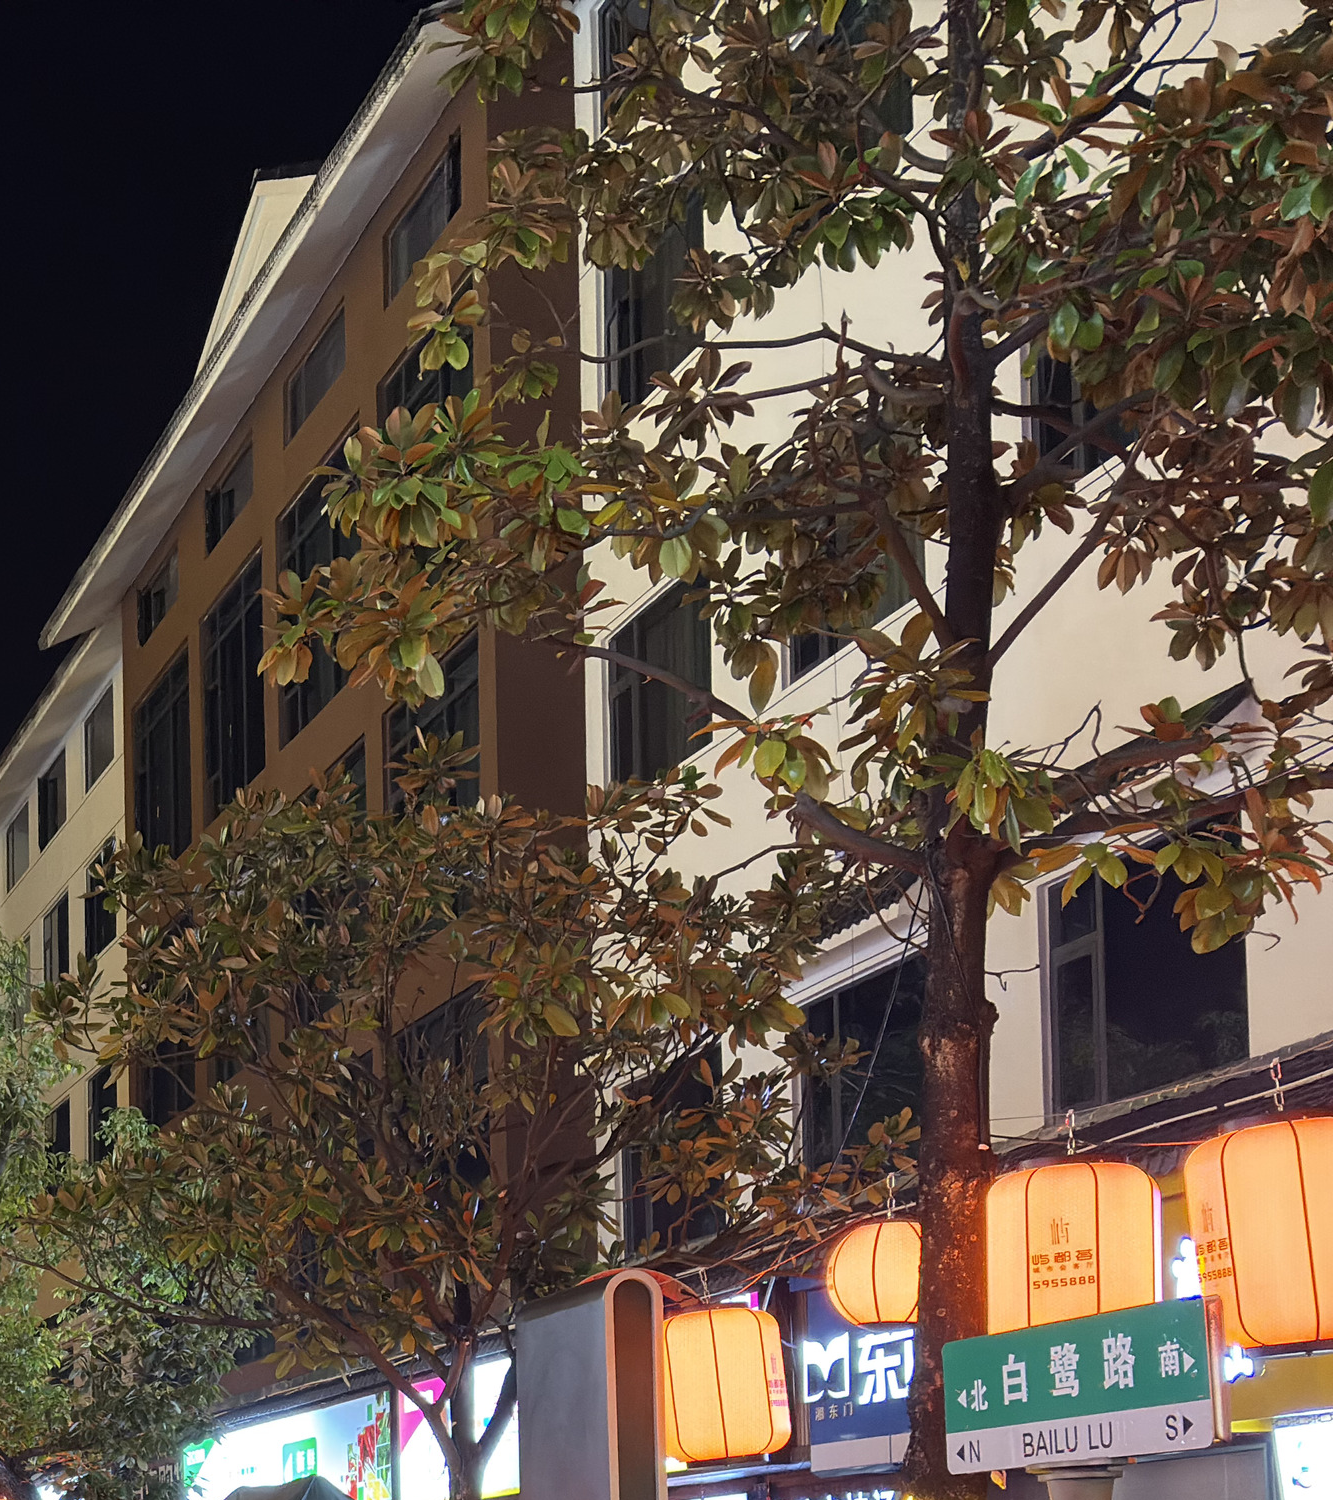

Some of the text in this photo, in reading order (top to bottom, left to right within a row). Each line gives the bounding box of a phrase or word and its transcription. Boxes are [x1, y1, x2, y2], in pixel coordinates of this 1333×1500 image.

[1033, 1275, 1095, 1289] 5955888
[970, 1333, 1181, 1412] 北 白鹭路 南
[968, 1414, 1179, 1464] N BAILU LU S
